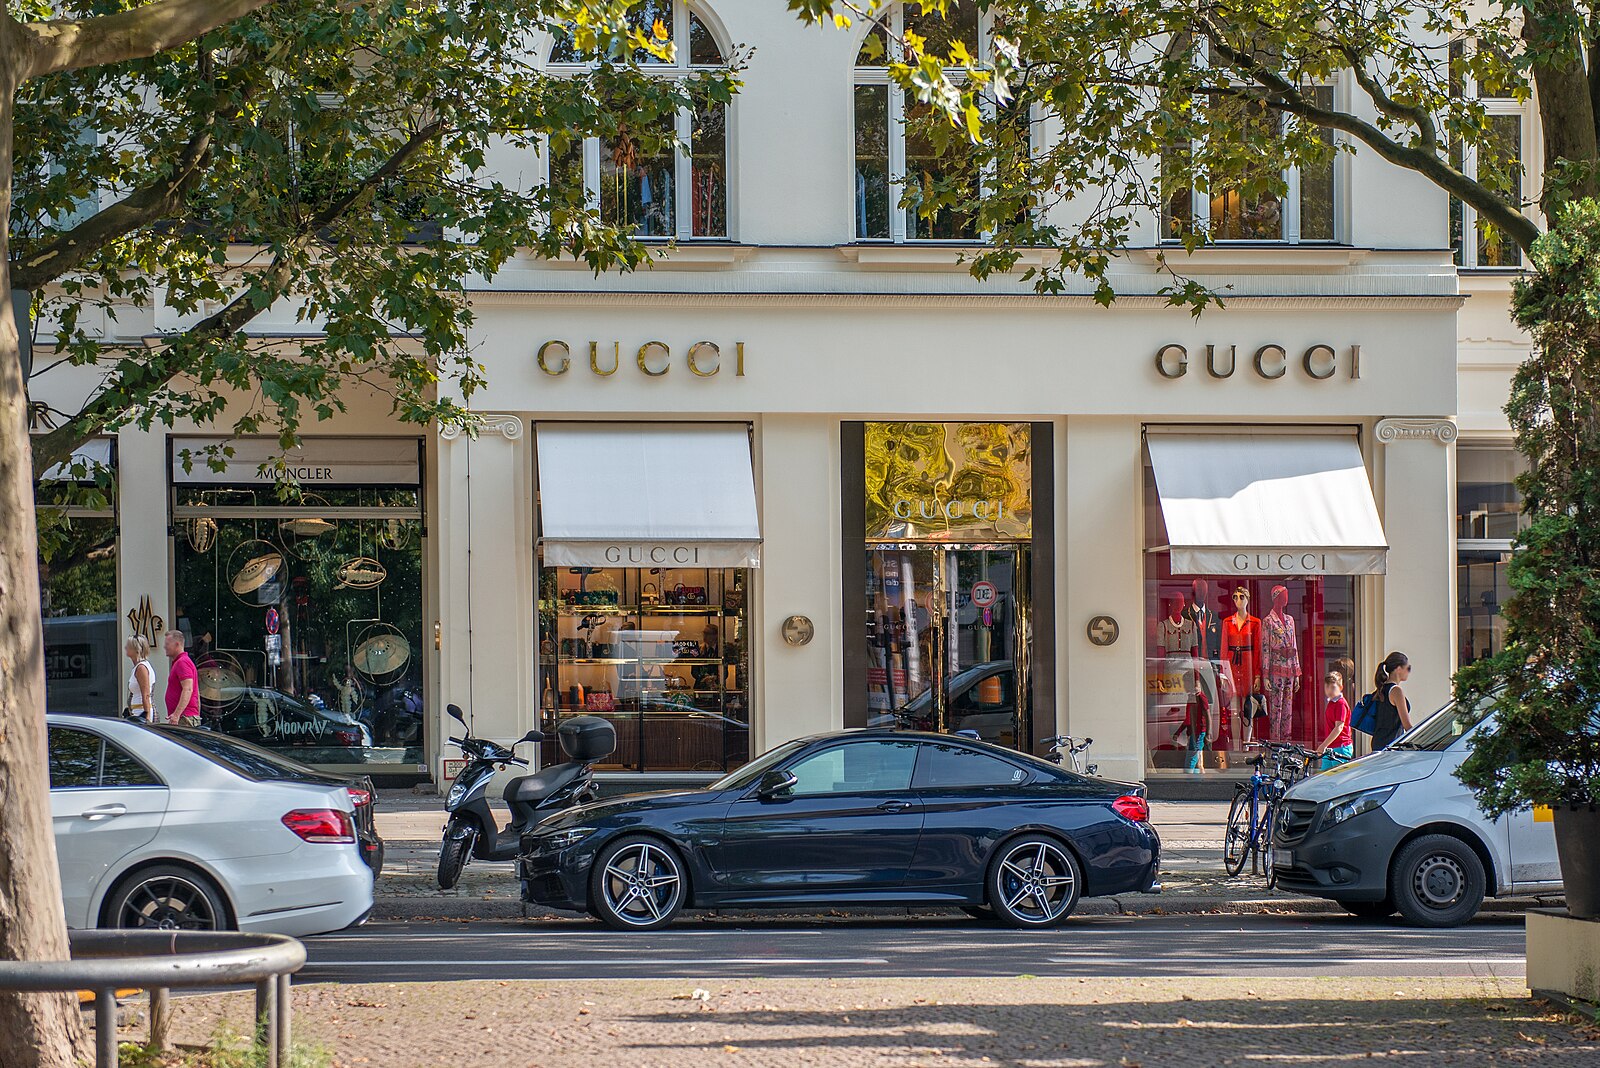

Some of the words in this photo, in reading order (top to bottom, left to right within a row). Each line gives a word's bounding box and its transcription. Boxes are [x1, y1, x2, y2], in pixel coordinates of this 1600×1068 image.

[537, 340, 745, 377] GUCCI
[1155, 344, 1361, 379] GUCCI
[258, 467, 333, 480] MONCLER
[893, 500, 1003, 519] GUCCI
[605, 546, 699, 563] GUCCI
[1233, 553, 1326, 570] GUCCI
